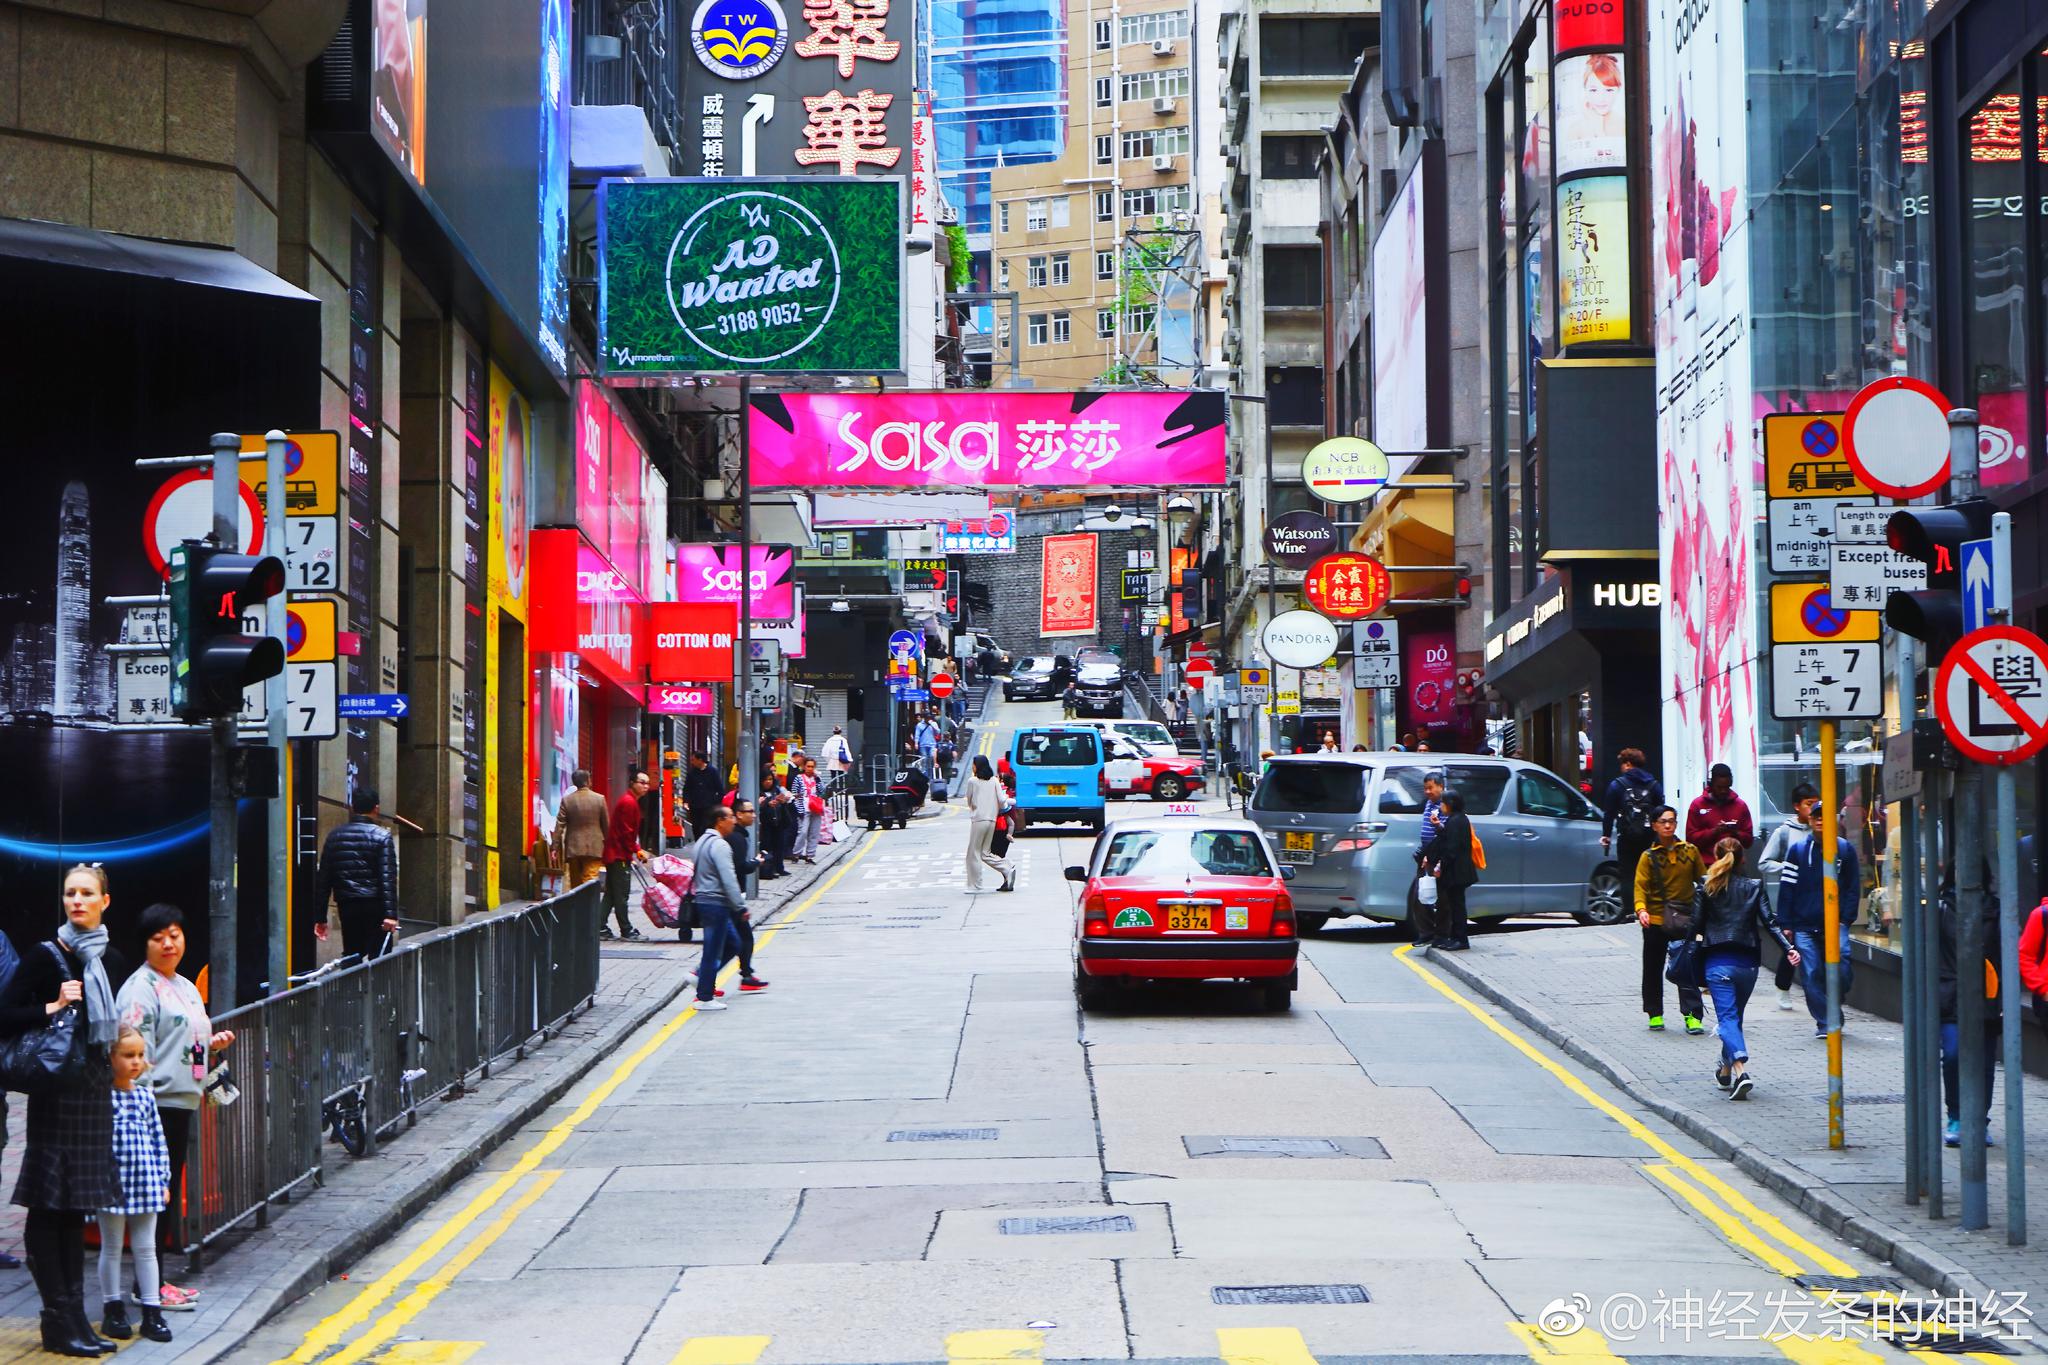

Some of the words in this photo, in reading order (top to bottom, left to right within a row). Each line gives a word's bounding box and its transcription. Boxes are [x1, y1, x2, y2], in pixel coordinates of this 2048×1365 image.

[702, 93, 724, 177] 威靈頓街
[712, 235, 779, 272] AD
[682, 258, 823, 308] Wanted
[717, 310, 758, 335] 3188
[761, 302, 802, 327] 9052
[836, 411, 1000, 472] Sasa
[1015, 419, 1121, 471] 莎莎
[1329, 452, 1360, 463] NCB
[1794, 502, 1811, 511] am
[1788, 514, 1818, 527] 上午
[1841, 511, 1875, 523] Length
[299, 522, 315, 545] 7
[1271, 526, 1330, 540] Watson's
[1271, 541, 1307, 554] Wine
[1776, 541, 1831, 553] midnight
[1789, 554, 1820, 567] 午夜
[1838, 550, 1889, 565] Except
[300, 562, 331, 586] 12
[1884, 566, 1926, 579] buses
[143, 624, 168, 636] 車長
[657, 633, 709, 648] COTTON
[712, 633, 731, 648] ON
[1271, 634, 1331, 644] PANDORA
[1800, 648, 1819, 656] am
[1382, 657, 1391, 669] 7
[1793, 660, 1826, 674] 上午
[1843, 649, 1860, 673] 7
[125, 662, 169, 676] Excep
[299, 669, 316, 693] 7
[760, 678, 771, 689] 7
[1383, 674, 1398, 686] 12
[660, 689, 702, 705] Sasa
[1800, 687, 1820, 698] pm
[762, 695, 777, 705] 12
[1794, 699, 1827, 713] 下午
[1843, 687, 1861, 712] 7
[299, 707, 316, 731] 7
[1168, 804, 1196, 813] TAXI
[1128, 913, 1138, 922] 5
[1171, 917, 1209, 929] 3374
